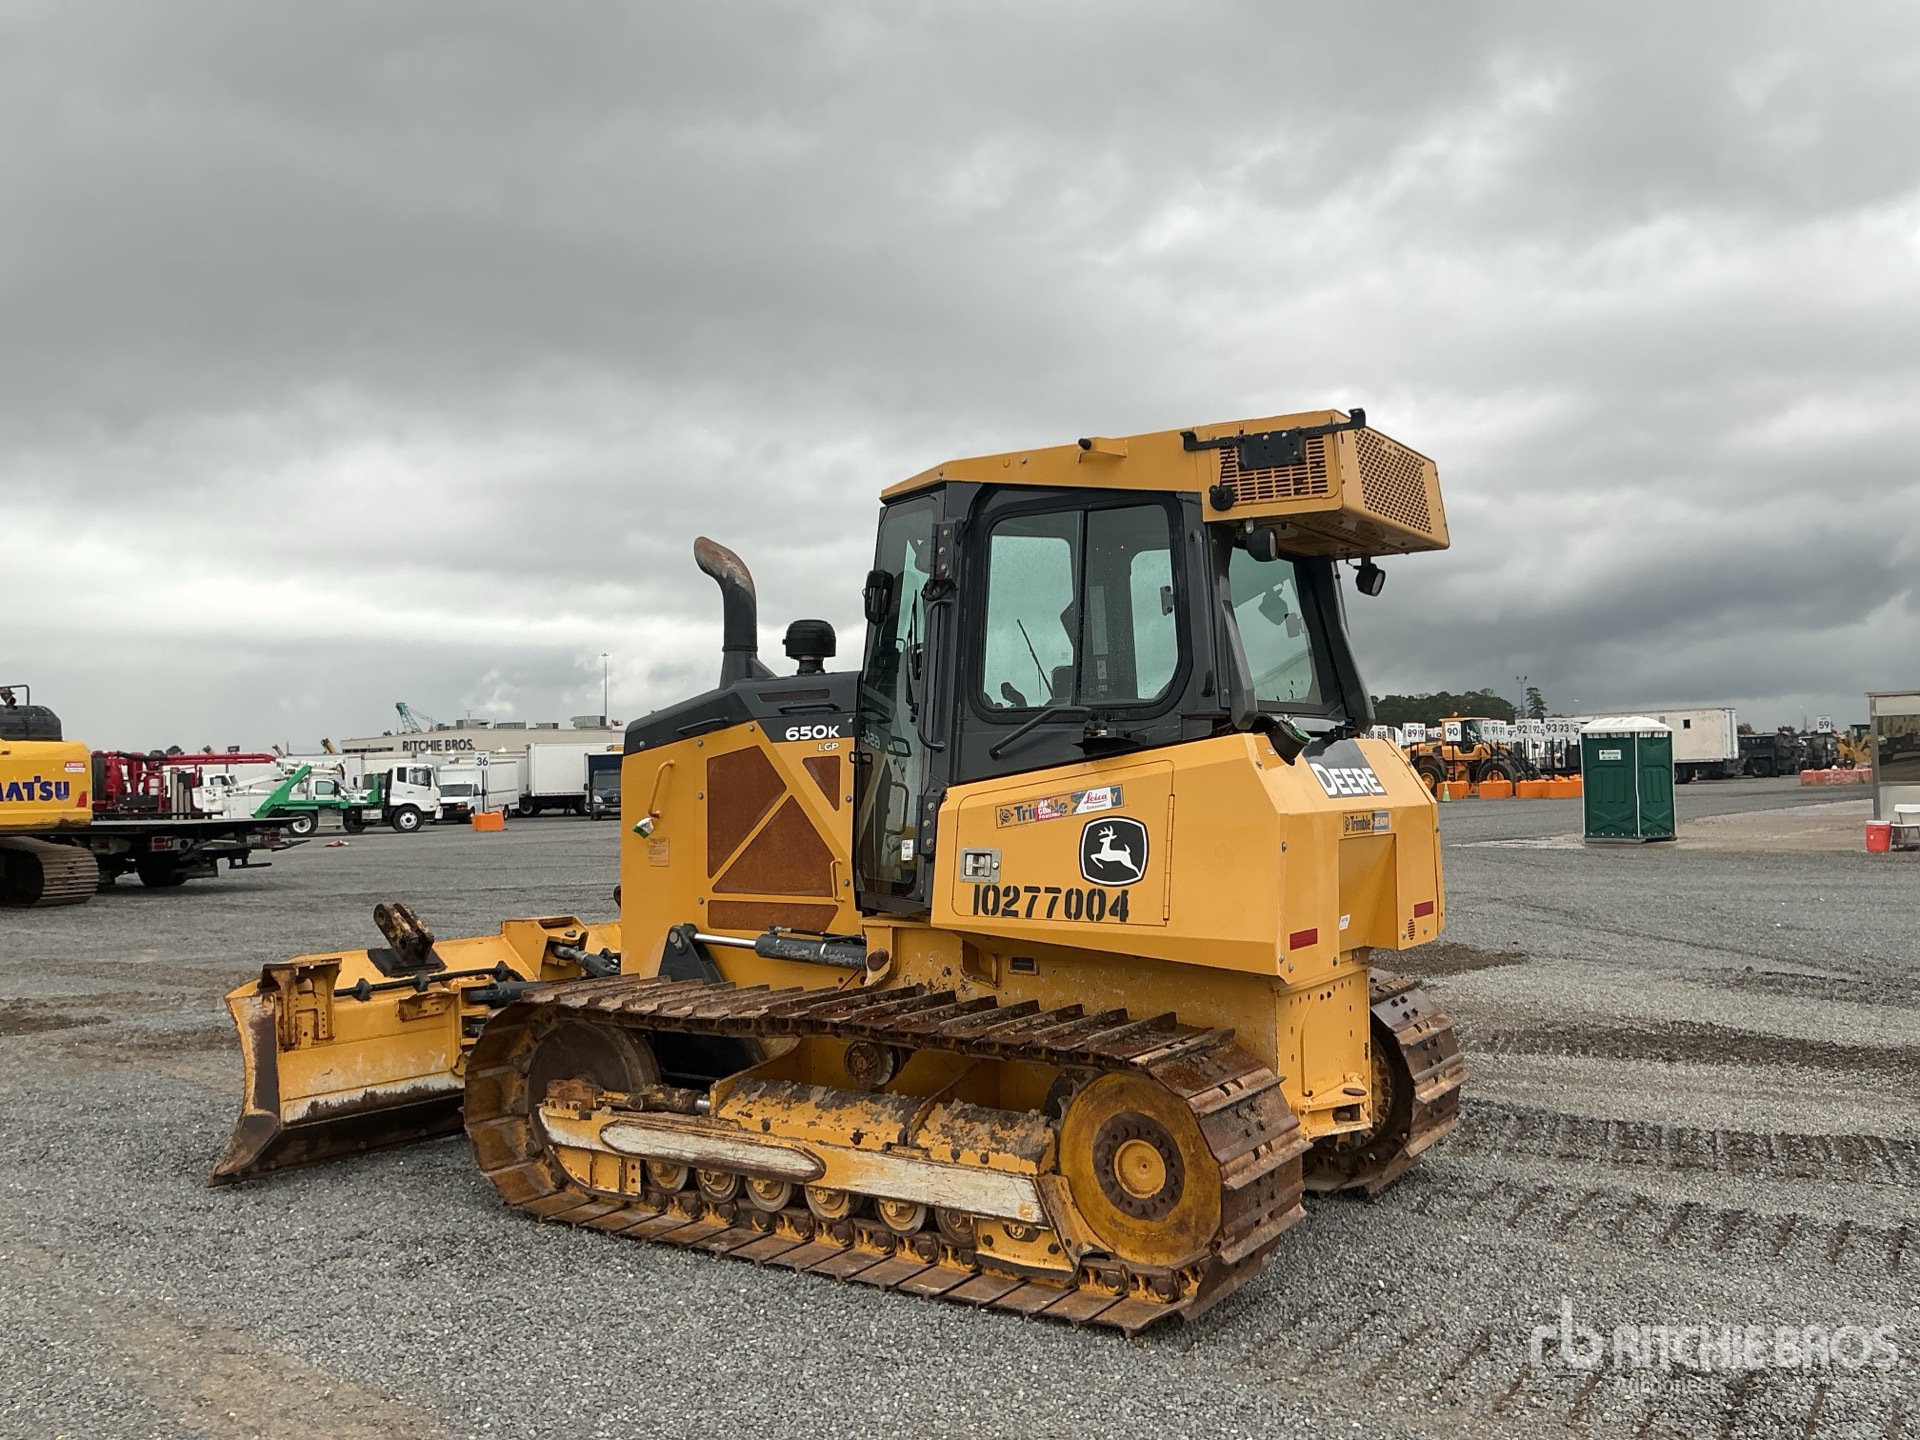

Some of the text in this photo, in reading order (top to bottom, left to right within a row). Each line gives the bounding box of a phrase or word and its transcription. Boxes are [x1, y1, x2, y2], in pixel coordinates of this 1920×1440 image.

[1516, 724, 1528, 734] 92
[1545, 723, 1557, 733] 93
[1818, 720, 1830, 729] 59
[785, 724, 840, 741] 650K
[1407, 729, 1417, 738] 89
[1446, 727, 1458, 737] 90
[402, 738, 476, 752] RITCHIE BROS.
[818, 742, 839, 751] LGP
[476, 756, 489, 767] 36
[1309, 763, 1385, 796] DEERE
[0, 775, 70, 802] ATSU
[1083, 791, 1109, 805] Leica
[1350, 815, 1389, 832] Trimble READY
[972, 884, 1129, 922] 10277004
